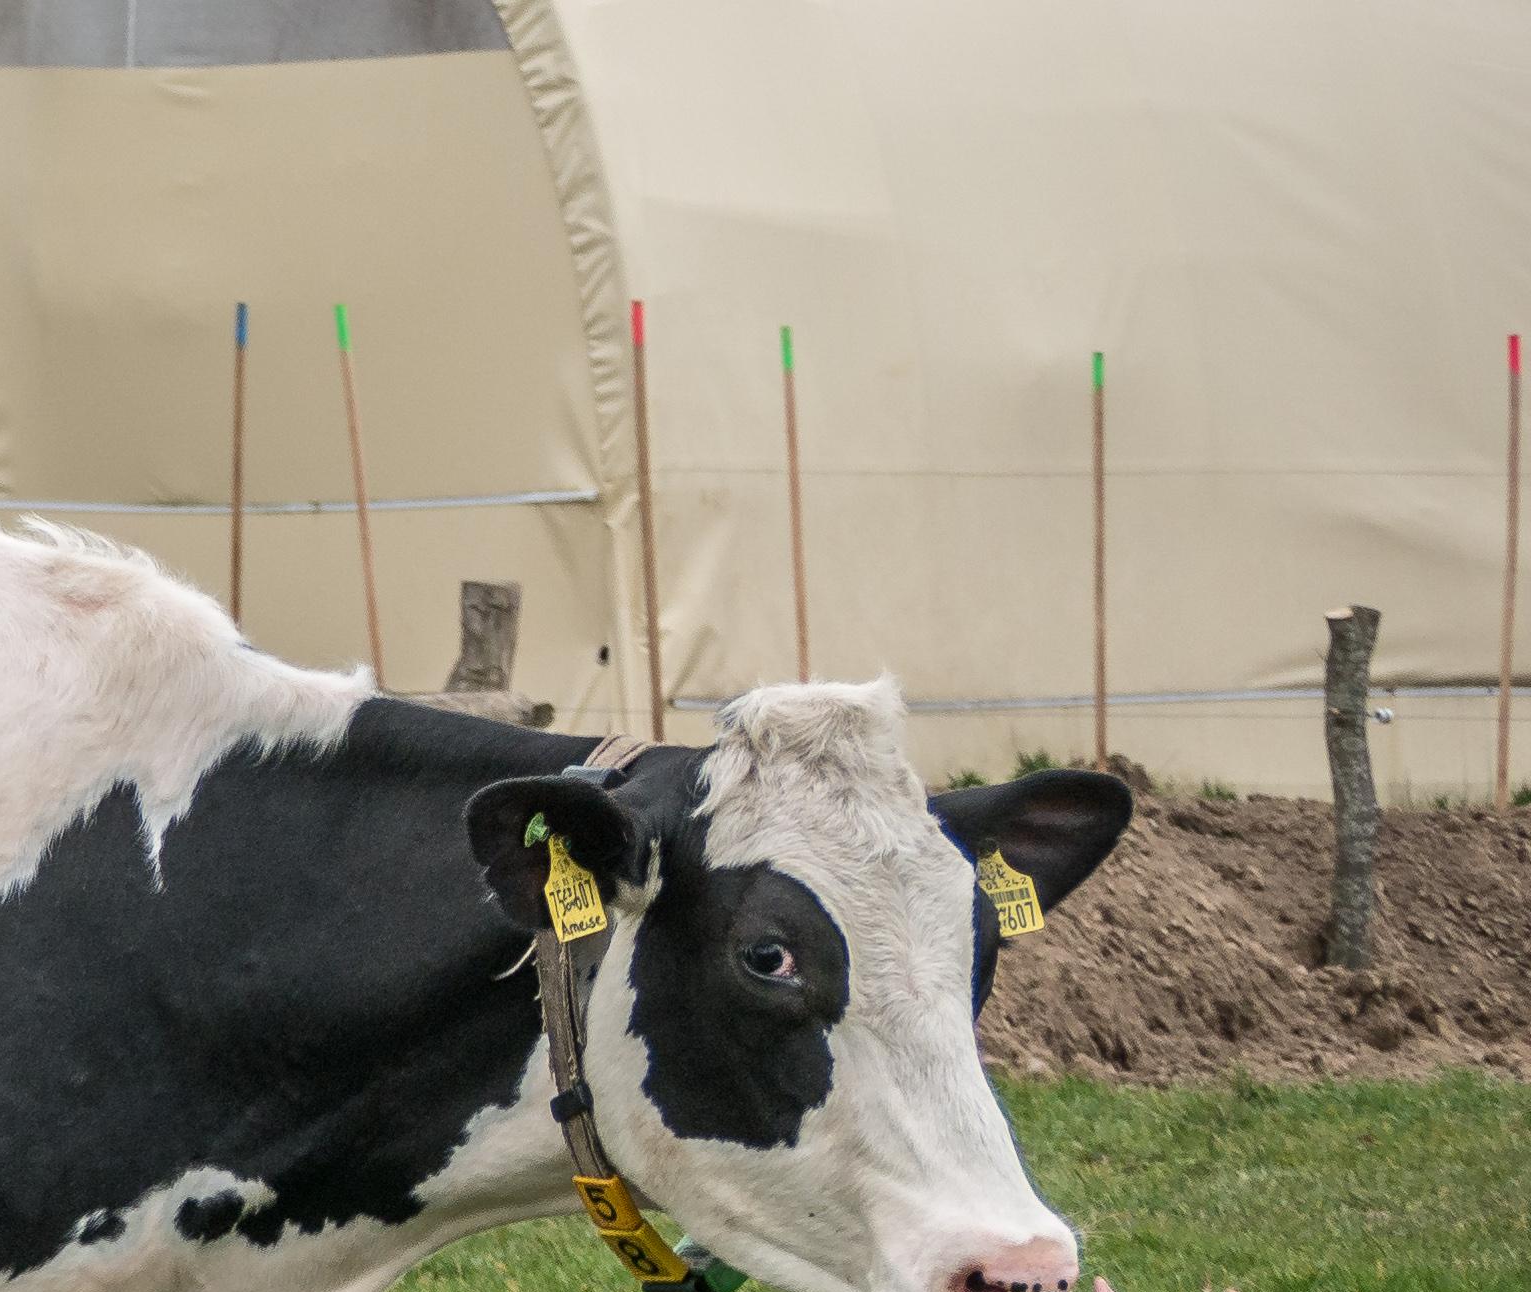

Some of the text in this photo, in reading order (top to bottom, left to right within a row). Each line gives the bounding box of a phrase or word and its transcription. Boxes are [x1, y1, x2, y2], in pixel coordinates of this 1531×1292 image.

[561, 915, 606, 940] Ameise
[1007, 902, 1035, 932] 607
[584, 1184, 660, 1275] 5 8
